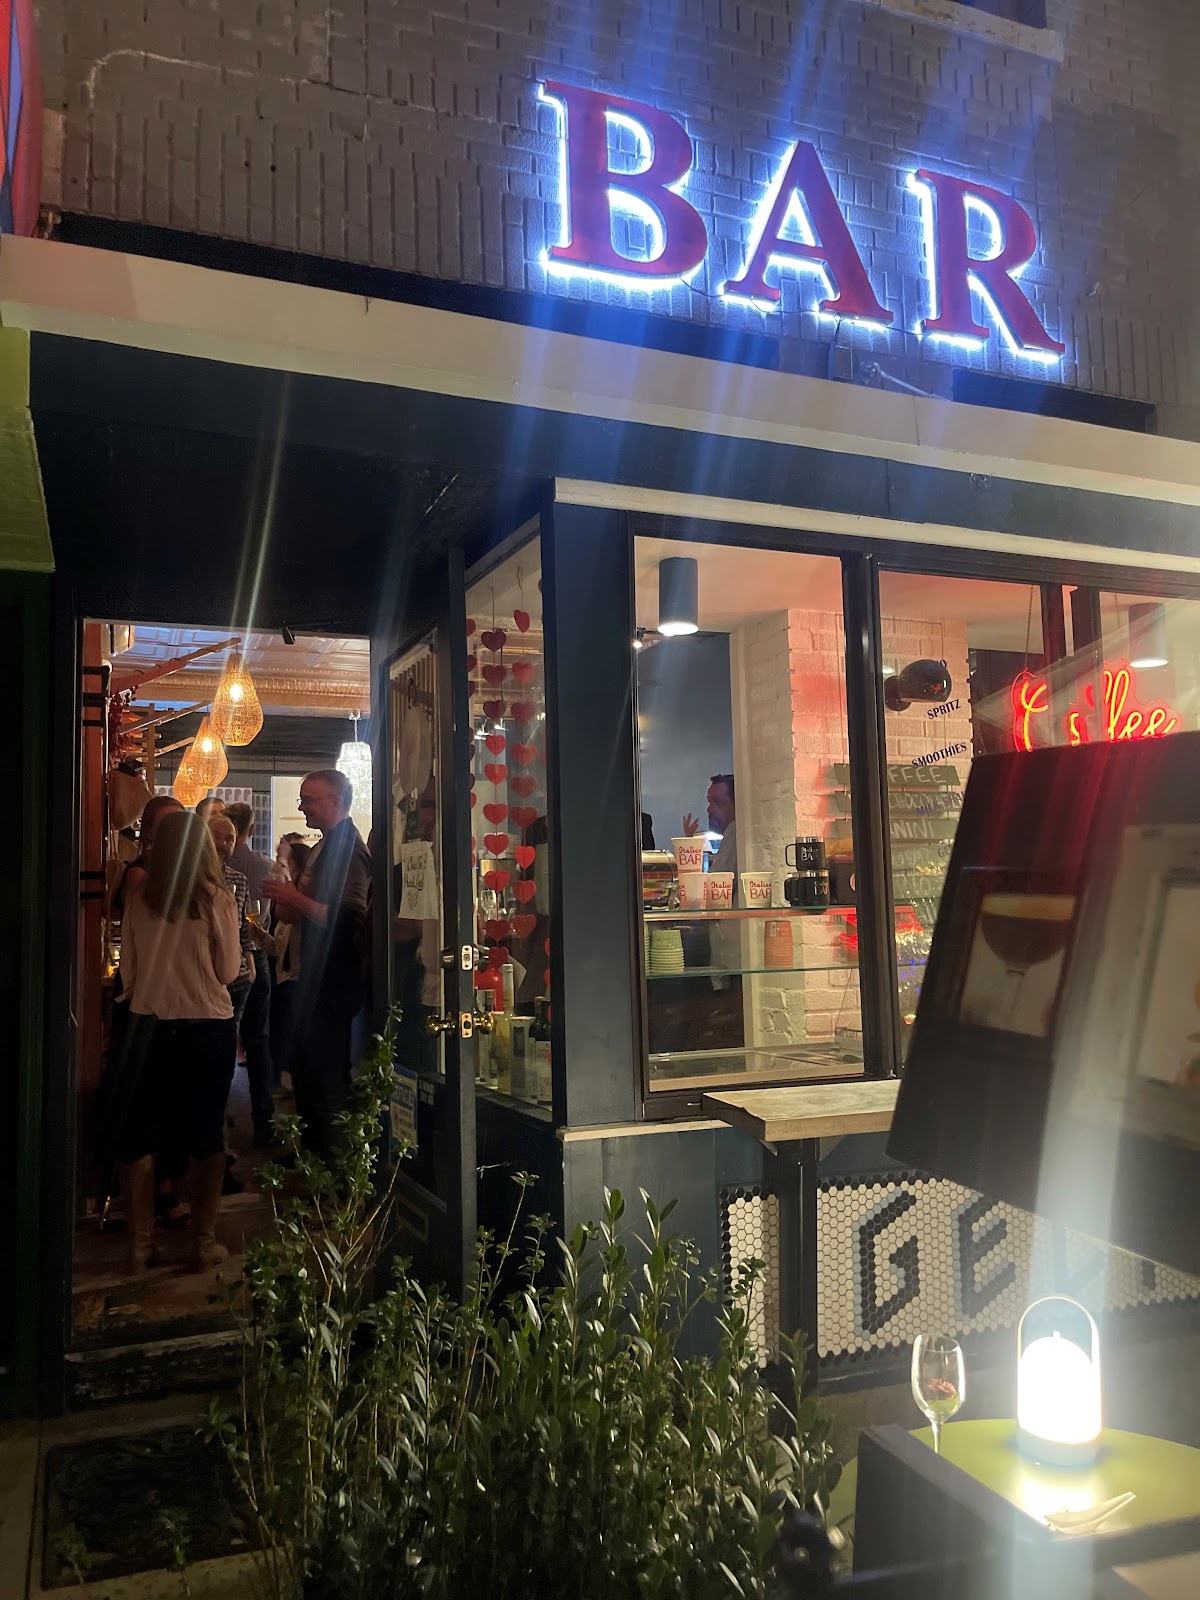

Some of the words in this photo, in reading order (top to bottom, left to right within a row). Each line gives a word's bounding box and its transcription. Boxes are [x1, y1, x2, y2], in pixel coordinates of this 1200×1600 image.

[540, 79, 1066, 361] BAR
[926, 699, 962, 720] SPRITZ
[911, 741, 968, 769] SMOOTHIES
[679, 853, 702, 866] BAR
